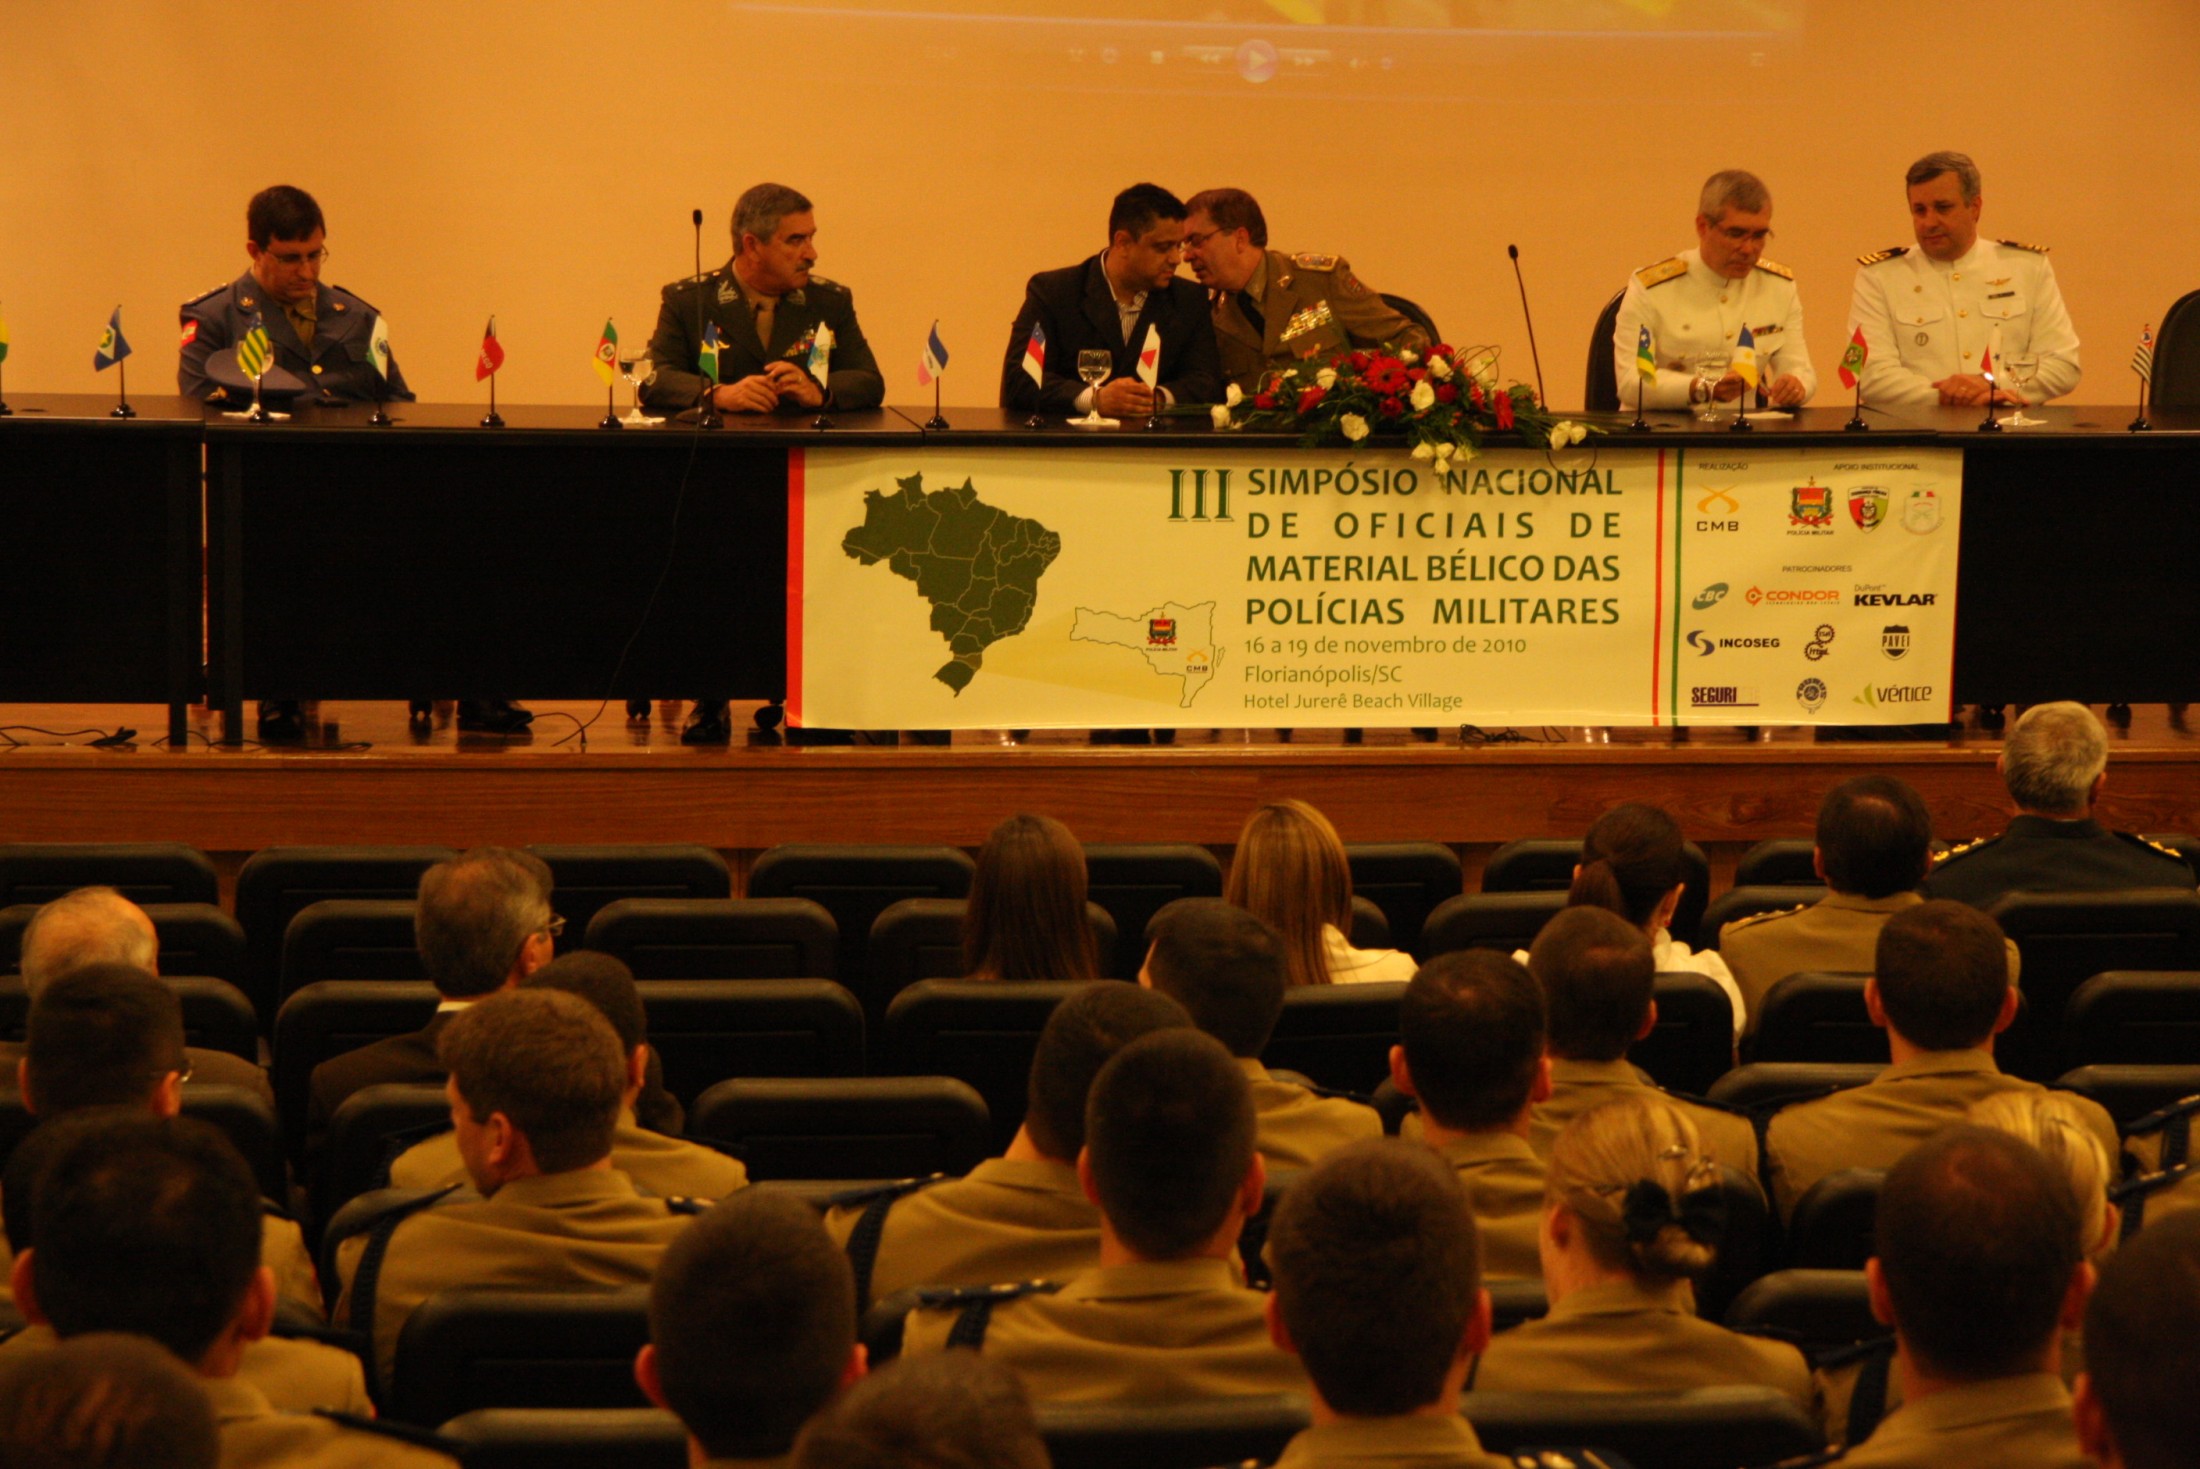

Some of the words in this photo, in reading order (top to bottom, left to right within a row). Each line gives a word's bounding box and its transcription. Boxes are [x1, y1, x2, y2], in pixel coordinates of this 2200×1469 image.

[1833, 463, 1859, 471] APOIO
[1861, 463, 1920, 471] INSTITUCIONAL
[1167, 469, 1235, 522] III
[1247, 462, 1418, 496] SIMPÓSIO
[1446, 469, 1622, 496] NACIONAL
[1248, 512, 1299, 539] DE
[1334, 511, 1534, 539] OFICIAIS
[1570, 512, 1621, 539] DE
[1696, 520, 1739, 532] CMB
[1246, 555, 1419, 582] MATERIAL
[1427, 548, 1545, 582] BÉLICO
[1554, 555, 1620, 582] DAS
[1782, 565, 1852, 573] PATROCINADORES
[1766, 590, 1840, 601] CONDOR
[1854, 593, 1935, 606] KEVLAR
[1246, 591, 1405, 625] POLÍCIAS
[1432, 598, 1620, 625] MILITARES
[1244, 636, 1265, 653] 16
[1270, 639, 1282, 653] a
[1288, 639, 1308, 658] 19
[1314, 635, 1338, 653] de
[1344, 635, 1447, 653] novembro
[1452, 635, 1477, 653] de
[1482, 639, 1527, 653] 2010
[1719, 638, 1780, 648] INCOSEG
[1245, 664, 1403, 687] Florianópolis/SC
[1244, 693, 1289, 708] Hotel
[1293, 693, 1348, 708] Jurerê
[1353, 693, 1403, 708] Beach
[1408, 693, 1463, 712] Village
